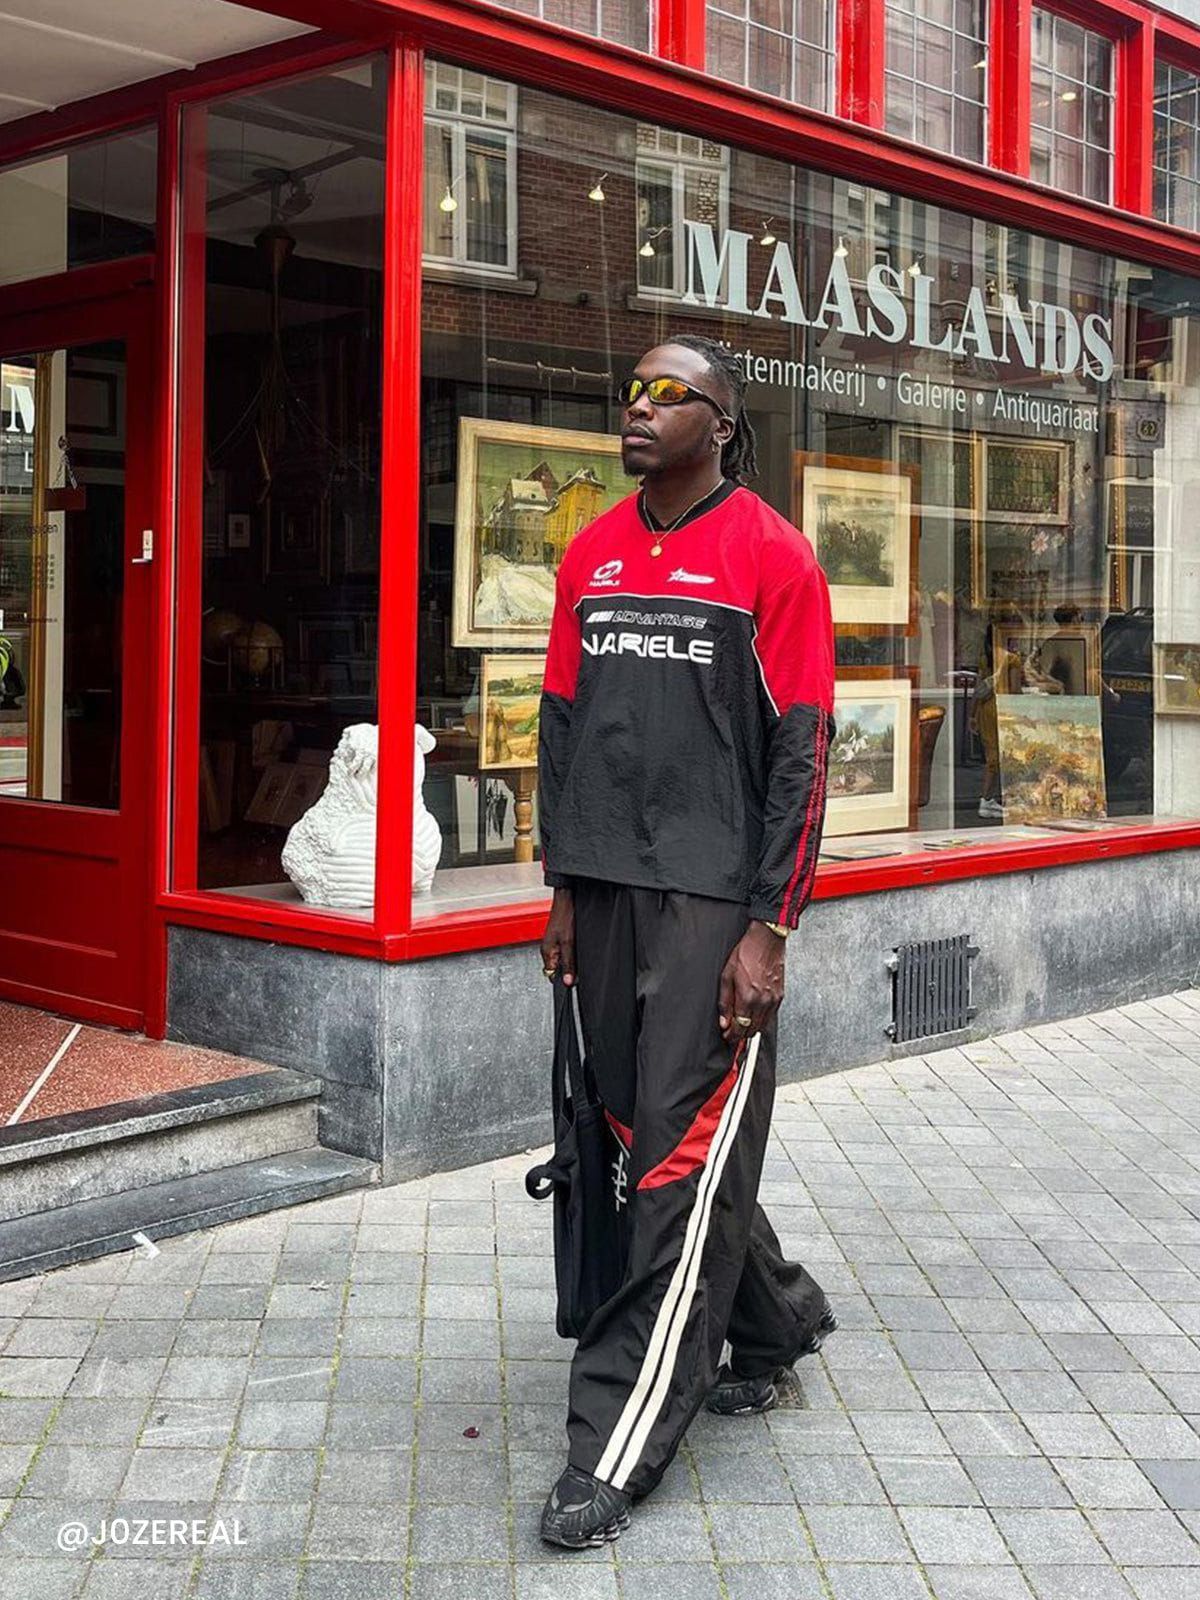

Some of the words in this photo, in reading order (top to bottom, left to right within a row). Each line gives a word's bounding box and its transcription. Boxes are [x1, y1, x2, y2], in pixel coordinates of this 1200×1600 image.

[682, 219, 1114, 382] MAASLANDS
[897, 372, 967, 413] Galerie
[992, 388, 1099, 433] Antiquariaat
[612, 610, 707, 630] ADVANTAGE
